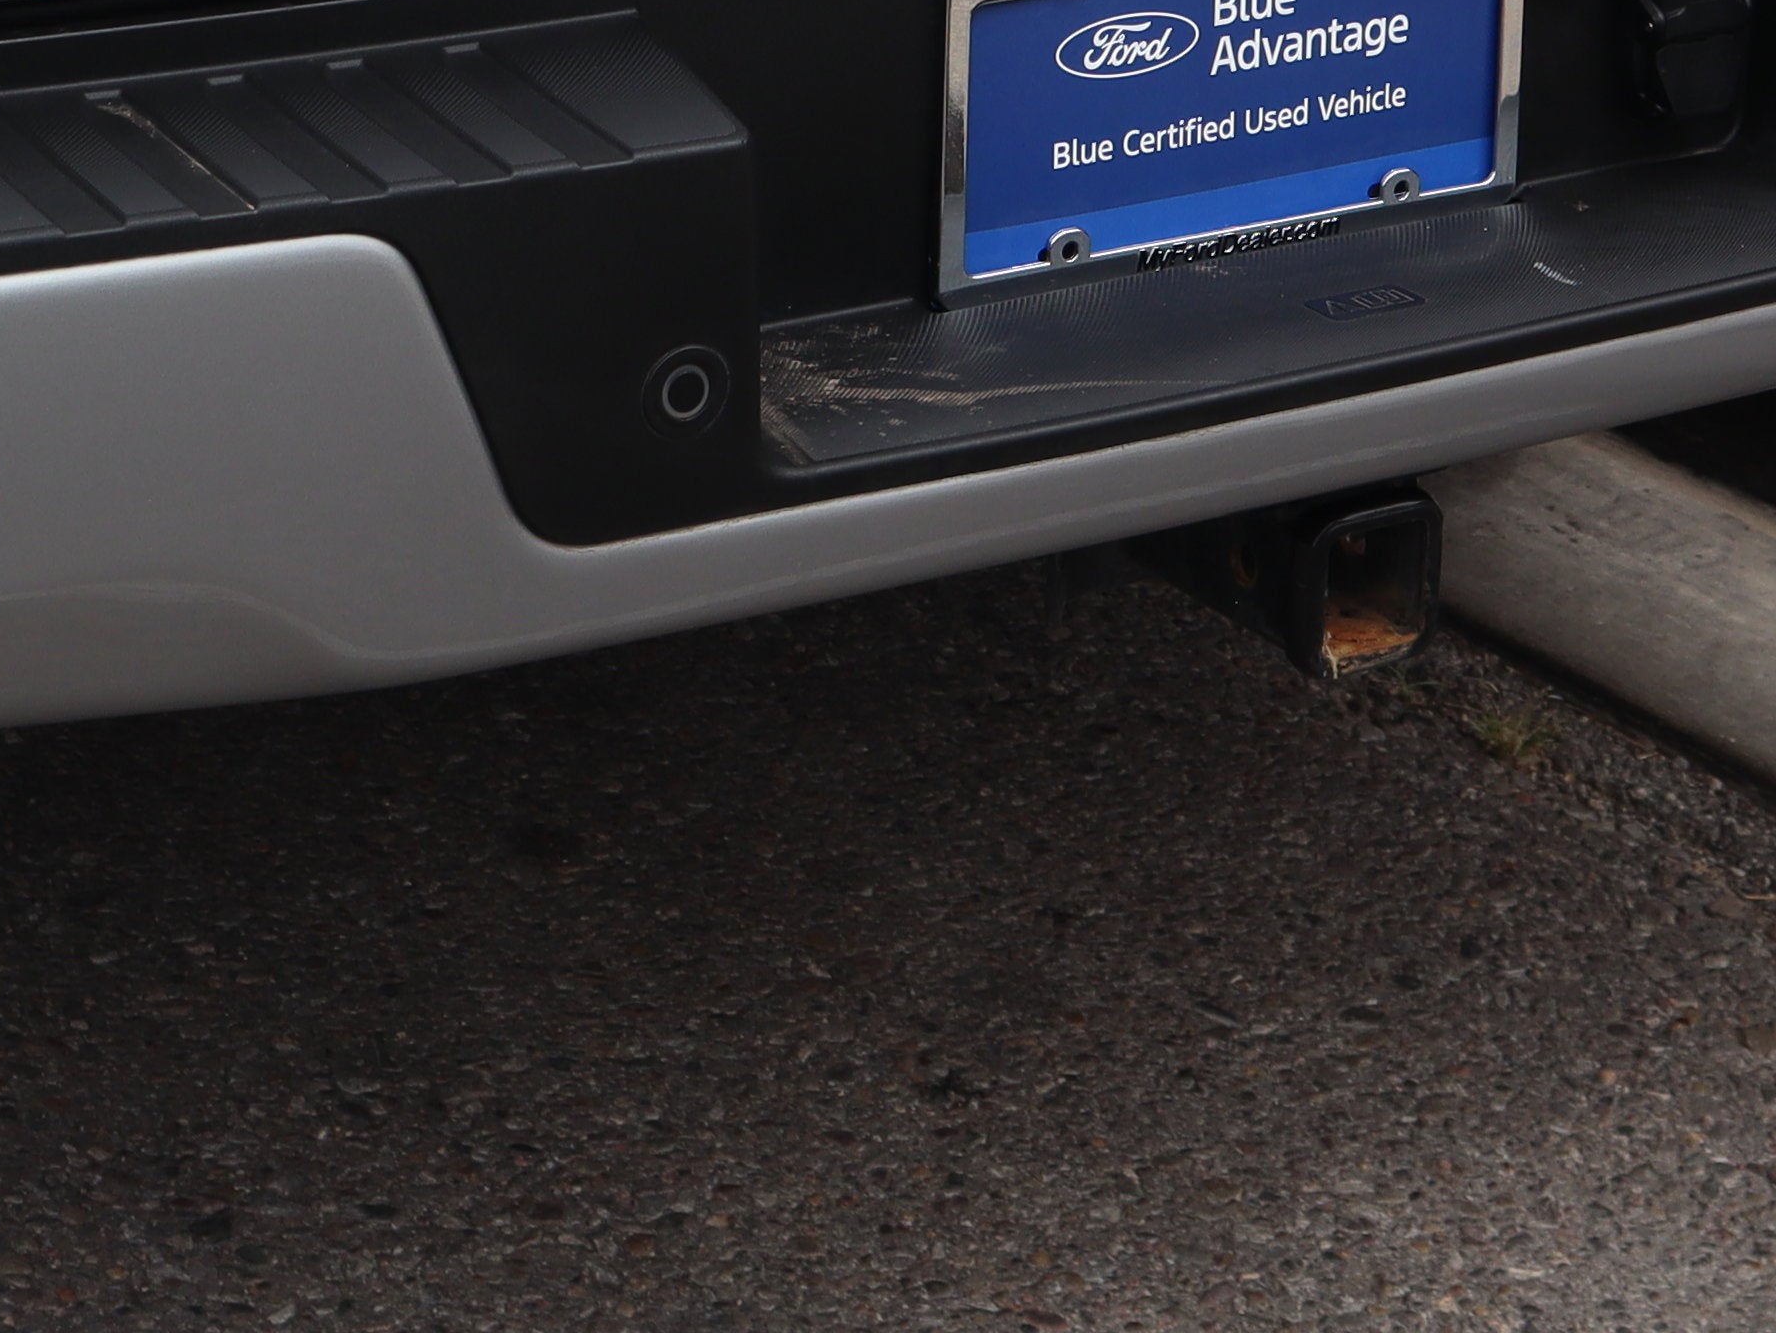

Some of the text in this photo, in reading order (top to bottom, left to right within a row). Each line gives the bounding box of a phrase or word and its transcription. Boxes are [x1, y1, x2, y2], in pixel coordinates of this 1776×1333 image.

[1082, 17, 1173, 70] Ford
[1210, 12, 1410, 76] Advantage
[1052, 83, 1408, 170] Blue Certified Used Vehicle
[1136, 217, 1341, 273] MyFordDealer.com
